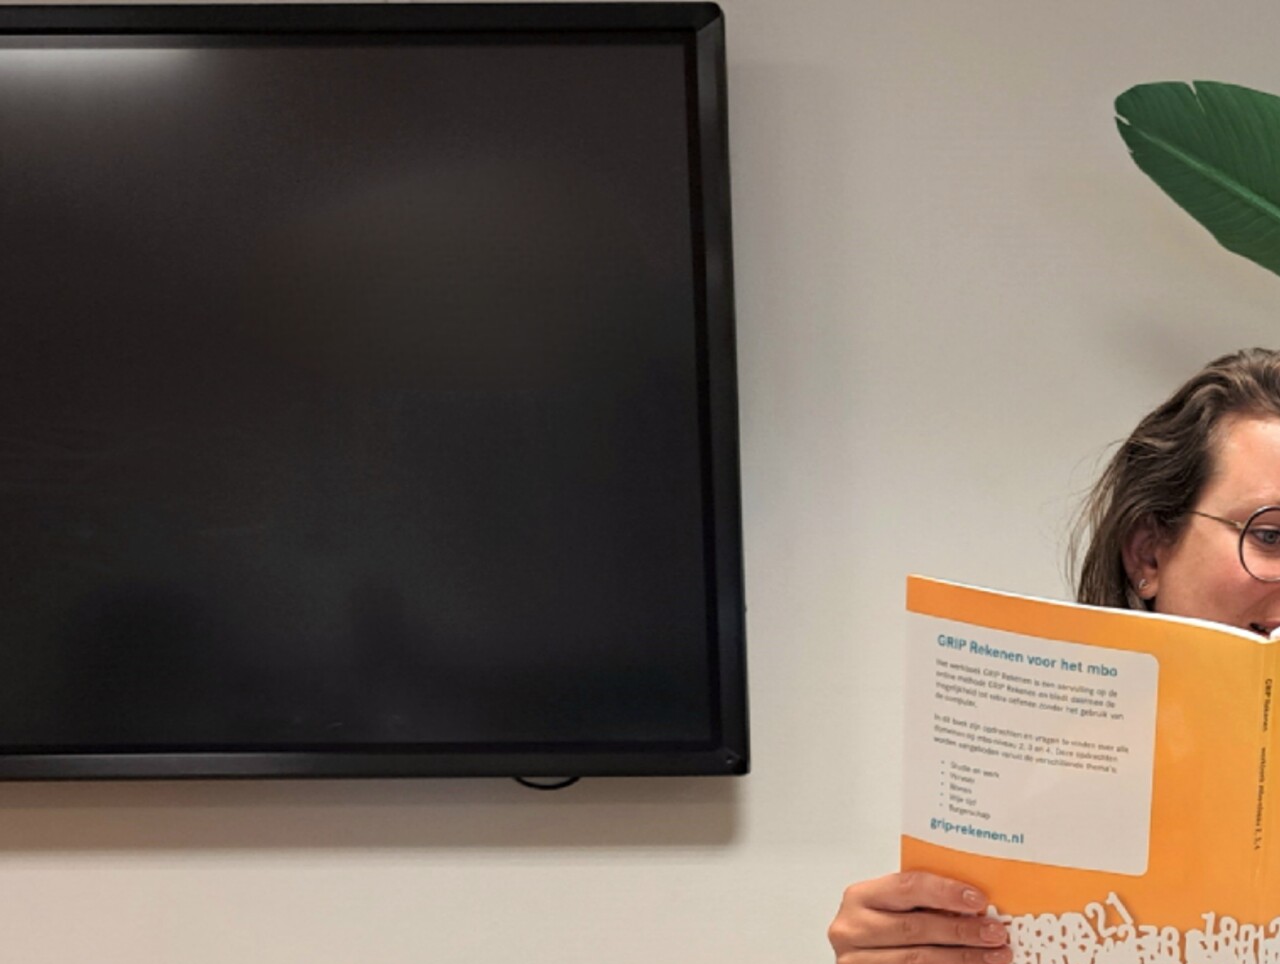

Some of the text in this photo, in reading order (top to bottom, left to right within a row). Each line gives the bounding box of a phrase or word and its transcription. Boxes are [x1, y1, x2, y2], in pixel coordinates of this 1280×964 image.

[937, 634, 1118, 677] GRIP Rekenen voor het mbo
[930, 817, 1024, 844] grip-rekenen.nl
